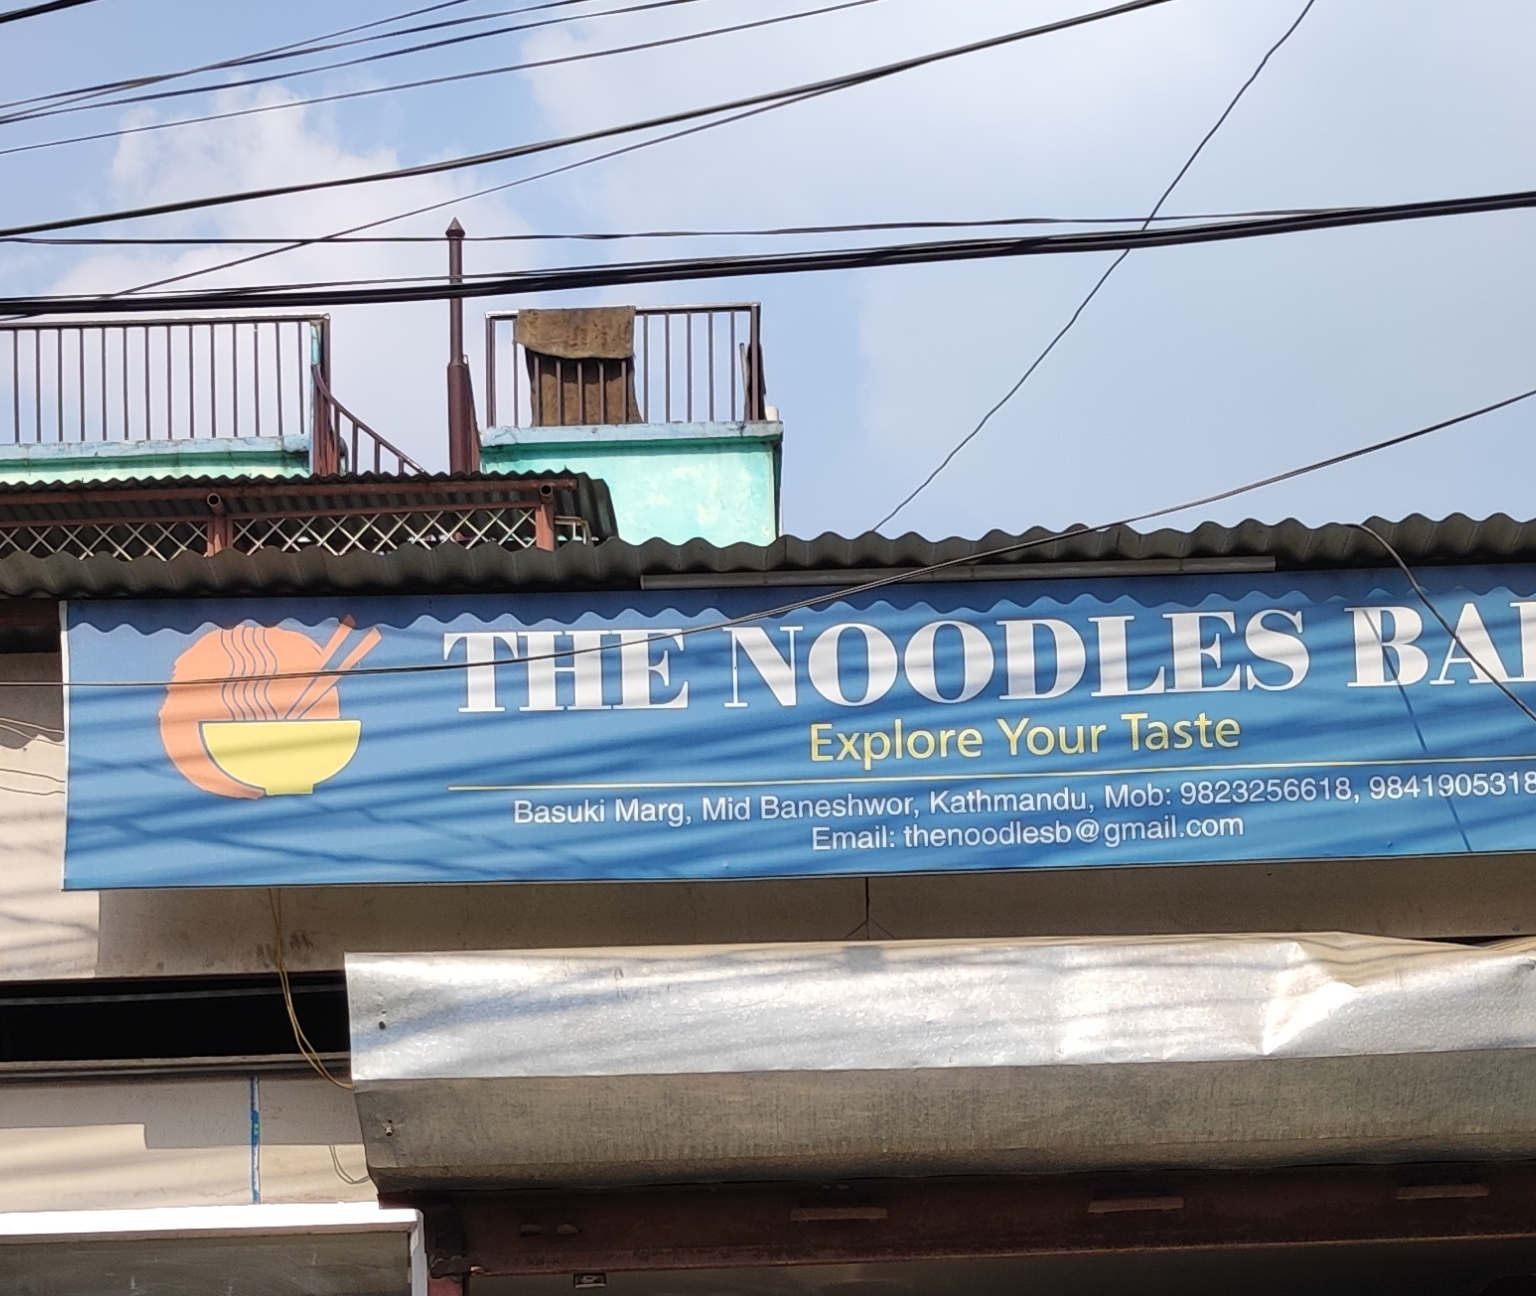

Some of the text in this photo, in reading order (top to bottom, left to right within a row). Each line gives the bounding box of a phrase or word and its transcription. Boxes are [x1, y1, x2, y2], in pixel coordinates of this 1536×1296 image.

[443, 627, 689, 713] THE
[721, 608, 1311, 708] NOODLES
[810, 711, 1241, 770] Explore Your Taste
[513, 798, 605, 824] Basuki
[615, 797, 692, 828] Marg,
[701, 795, 752, 821] Mid
[760, 791, 919, 822] Baneshwor,
[929, 787, 1097, 816] Kathmandu,
[1104, 782, 1172, 809] Mob:
[1179, 775, 1360, 806] 9823256618,
[811, 815, 1245, 850] Email: thenoodlesb@gmail.com
